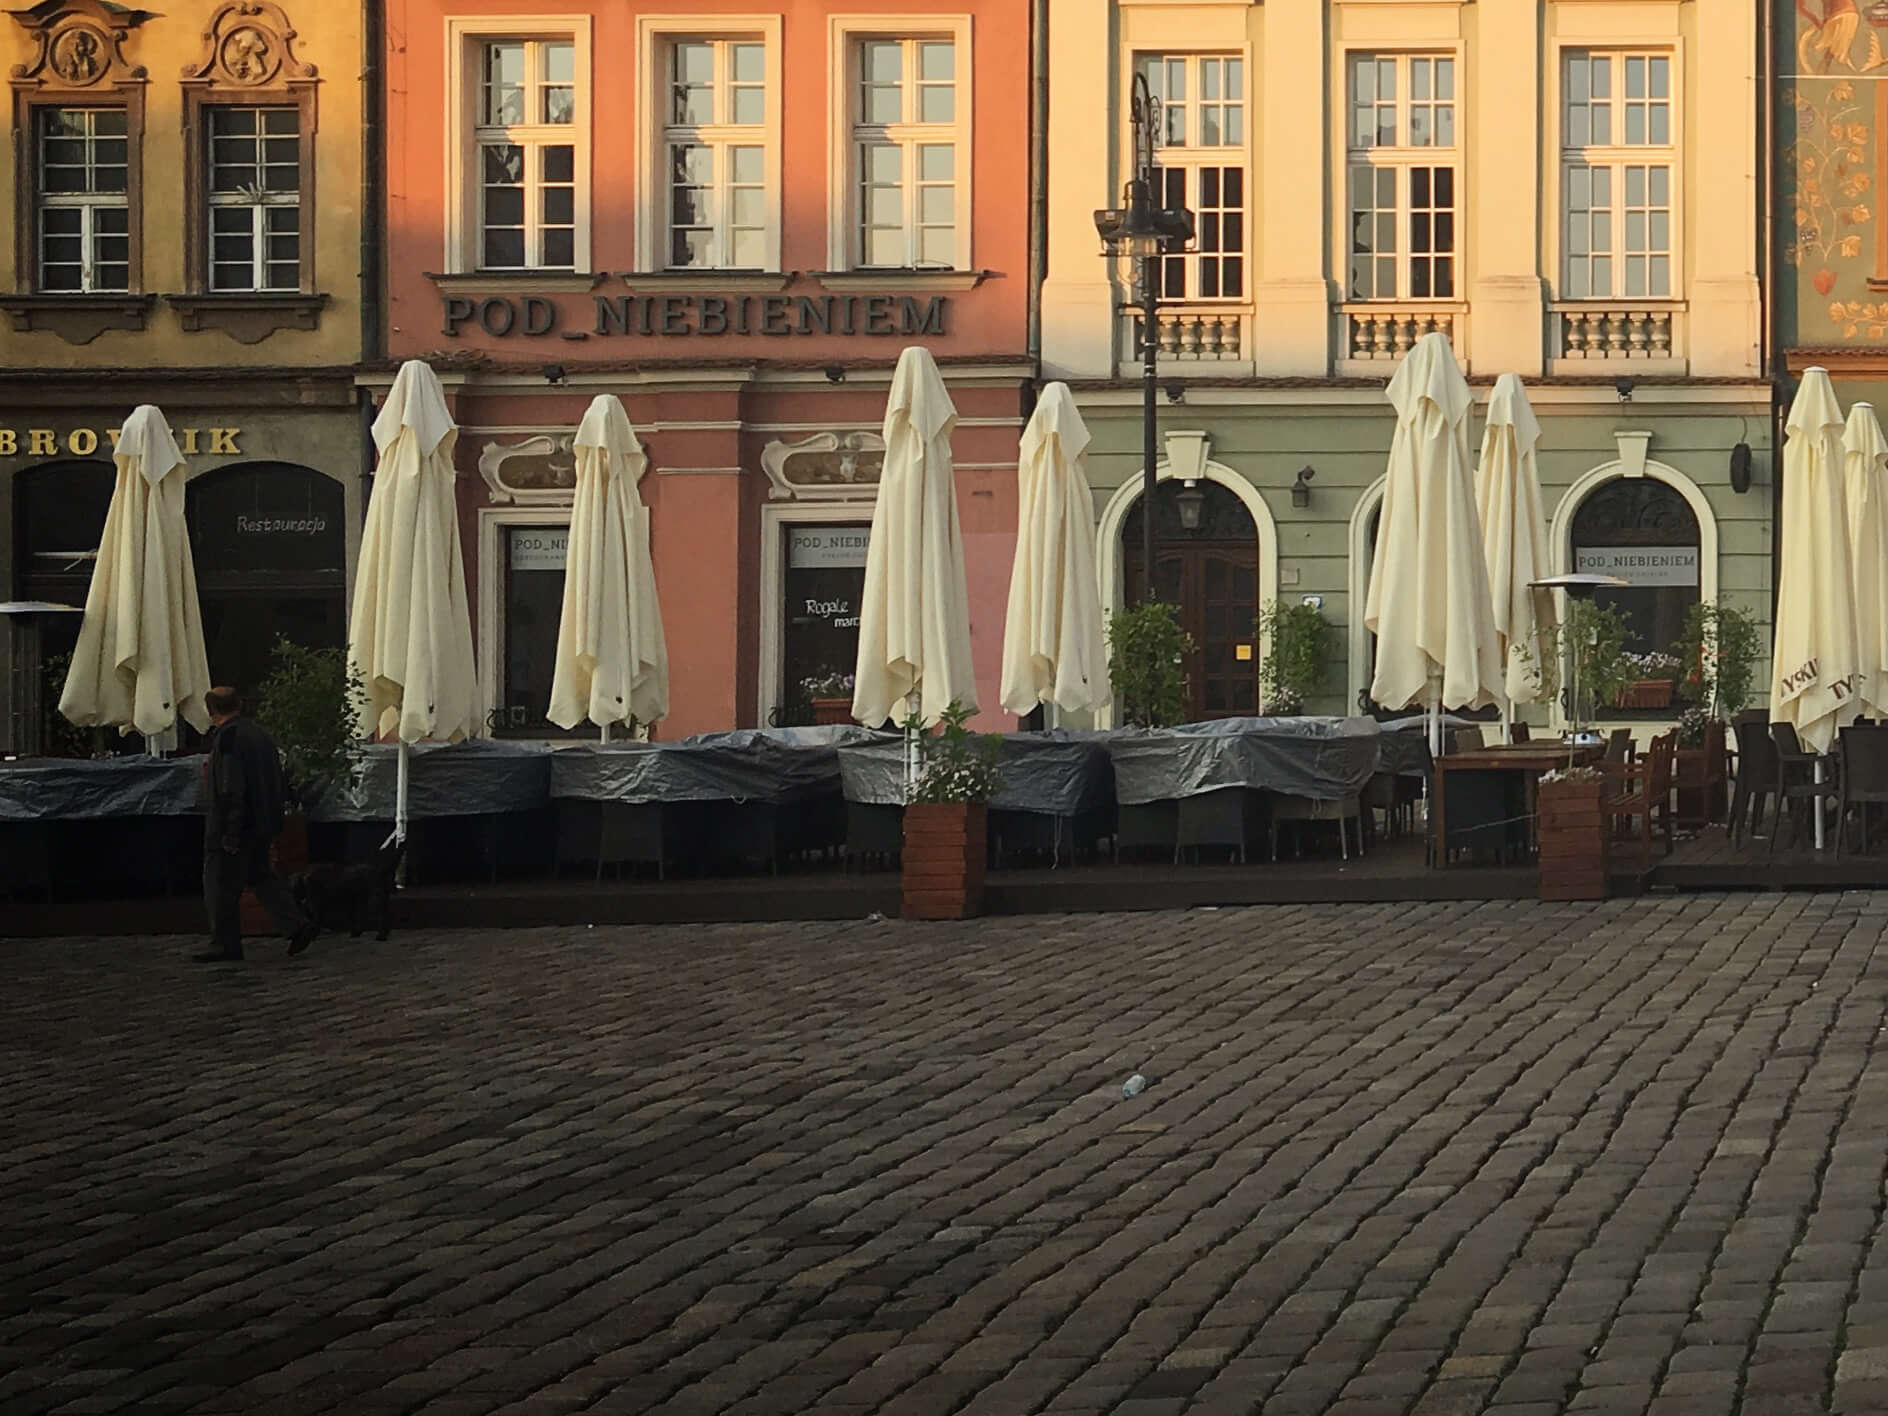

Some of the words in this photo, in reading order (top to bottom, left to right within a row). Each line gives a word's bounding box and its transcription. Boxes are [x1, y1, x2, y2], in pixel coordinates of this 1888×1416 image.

[0, 428, 241, 456] BROIK
[236, 516, 327, 535] Restauracja
[794, 537, 870, 549] POD_NIEBI
[805, 598, 849, 618] Rogale
